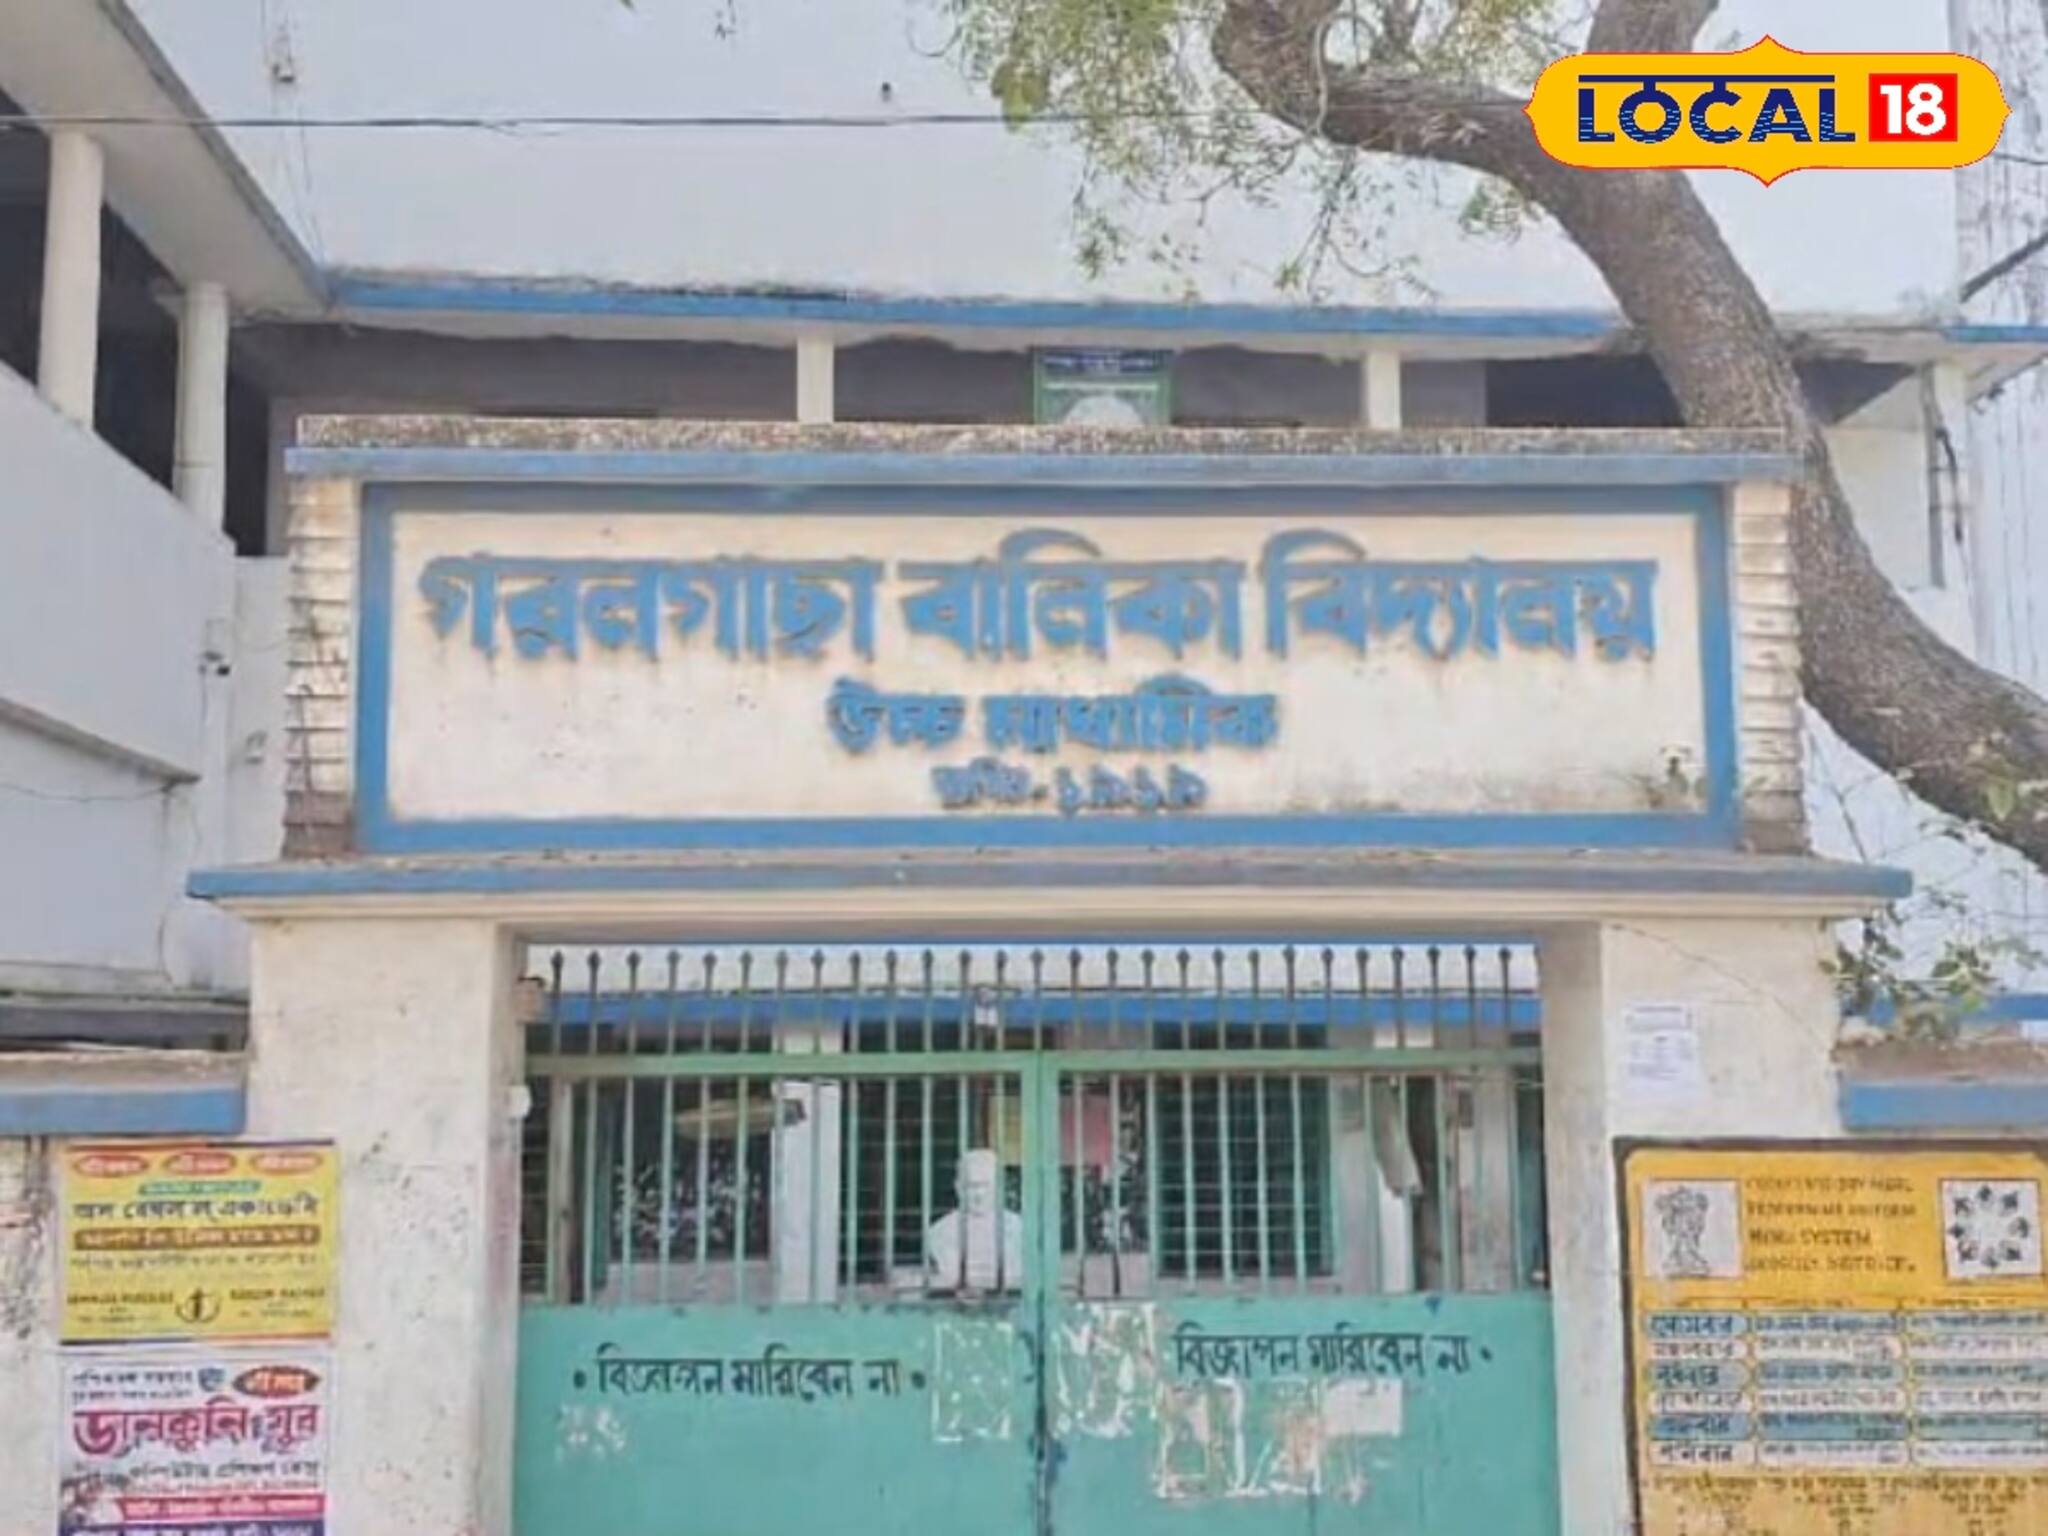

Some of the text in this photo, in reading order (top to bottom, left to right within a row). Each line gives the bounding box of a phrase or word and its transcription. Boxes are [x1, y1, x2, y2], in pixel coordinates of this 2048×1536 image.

[419, 528, 1659, 661] গরলগাছা বালিকা বিদ্যালয়
[827, 675, 964, 755] উচ্চ
[863, 1359, 902, 1396] না
[1431, 1335, 1470, 1373] না
